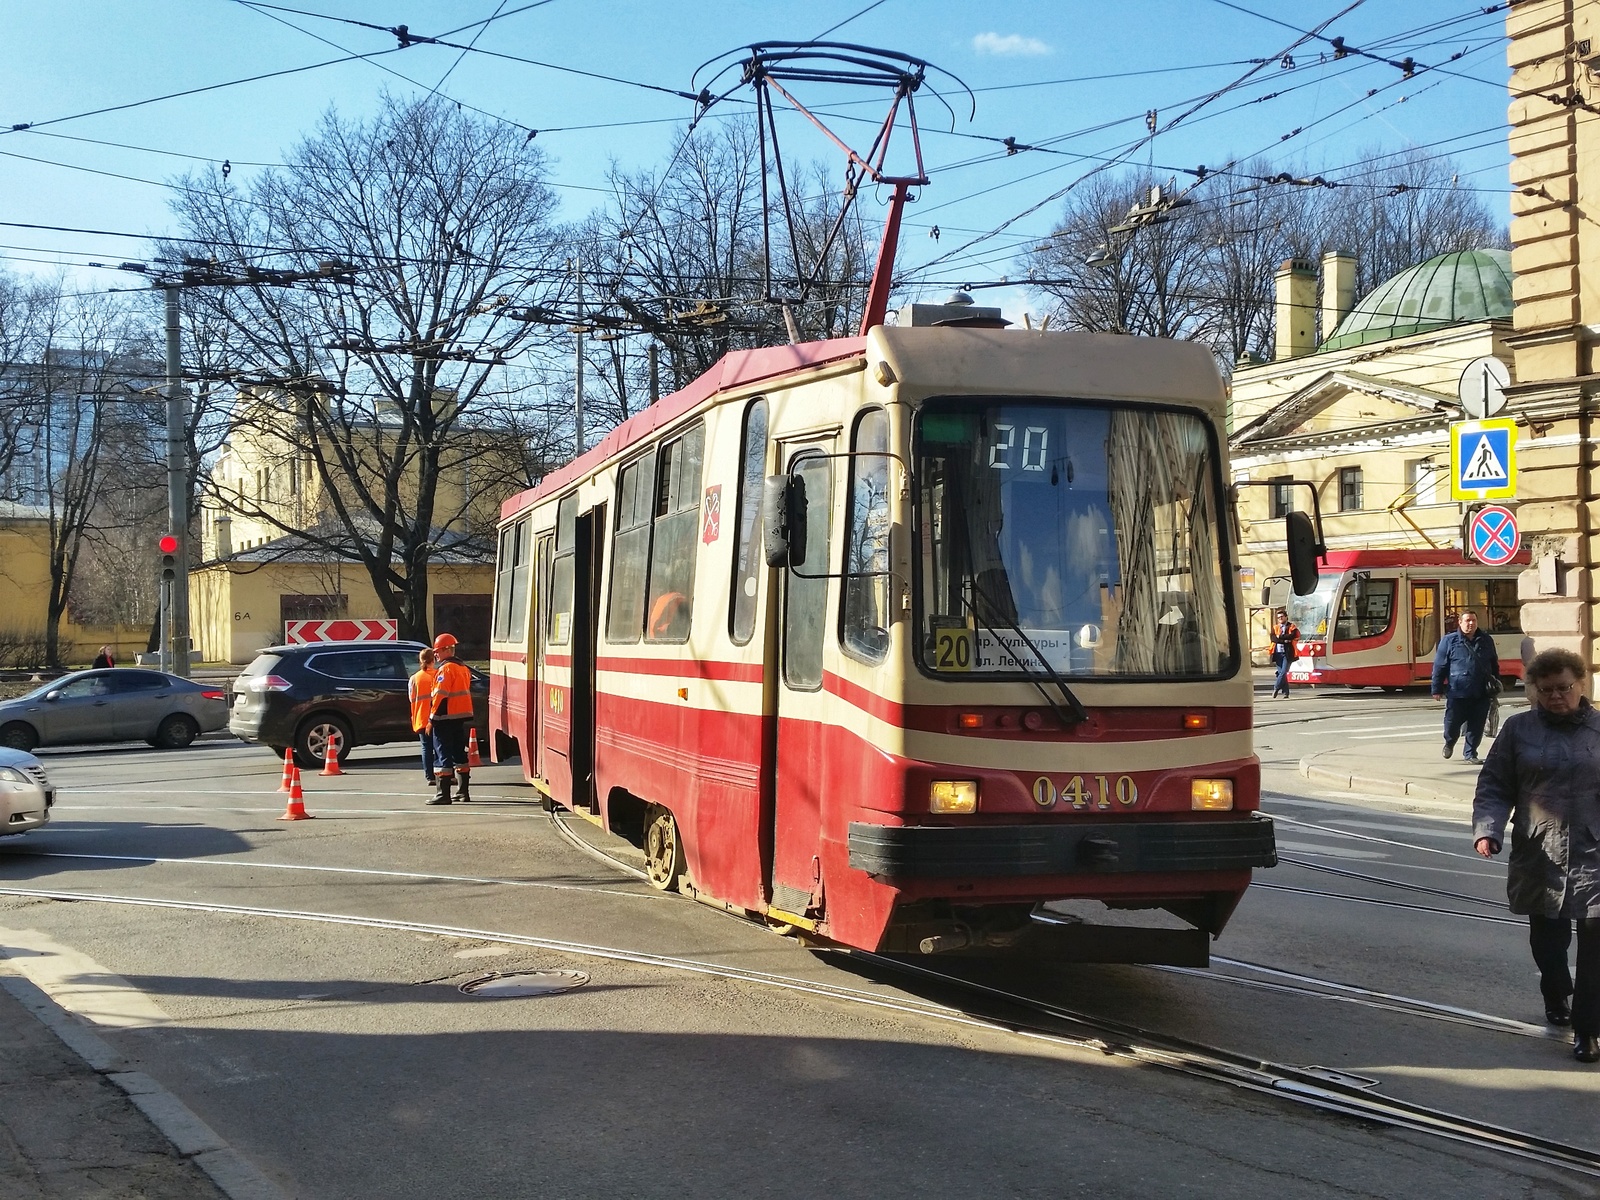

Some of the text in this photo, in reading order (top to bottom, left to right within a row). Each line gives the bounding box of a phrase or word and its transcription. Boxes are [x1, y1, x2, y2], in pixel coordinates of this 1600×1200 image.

[989, 424, 1049, 472] 20
[234, 611, 251, 621] 6А
[998, 636, 1058, 650] Кульуры
[939, 635, 970, 667] 20
[976, 657, 994, 666] л.
[1291, 671, 1310, 681] 3706
[1032, 775, 1138, 810] 0410
